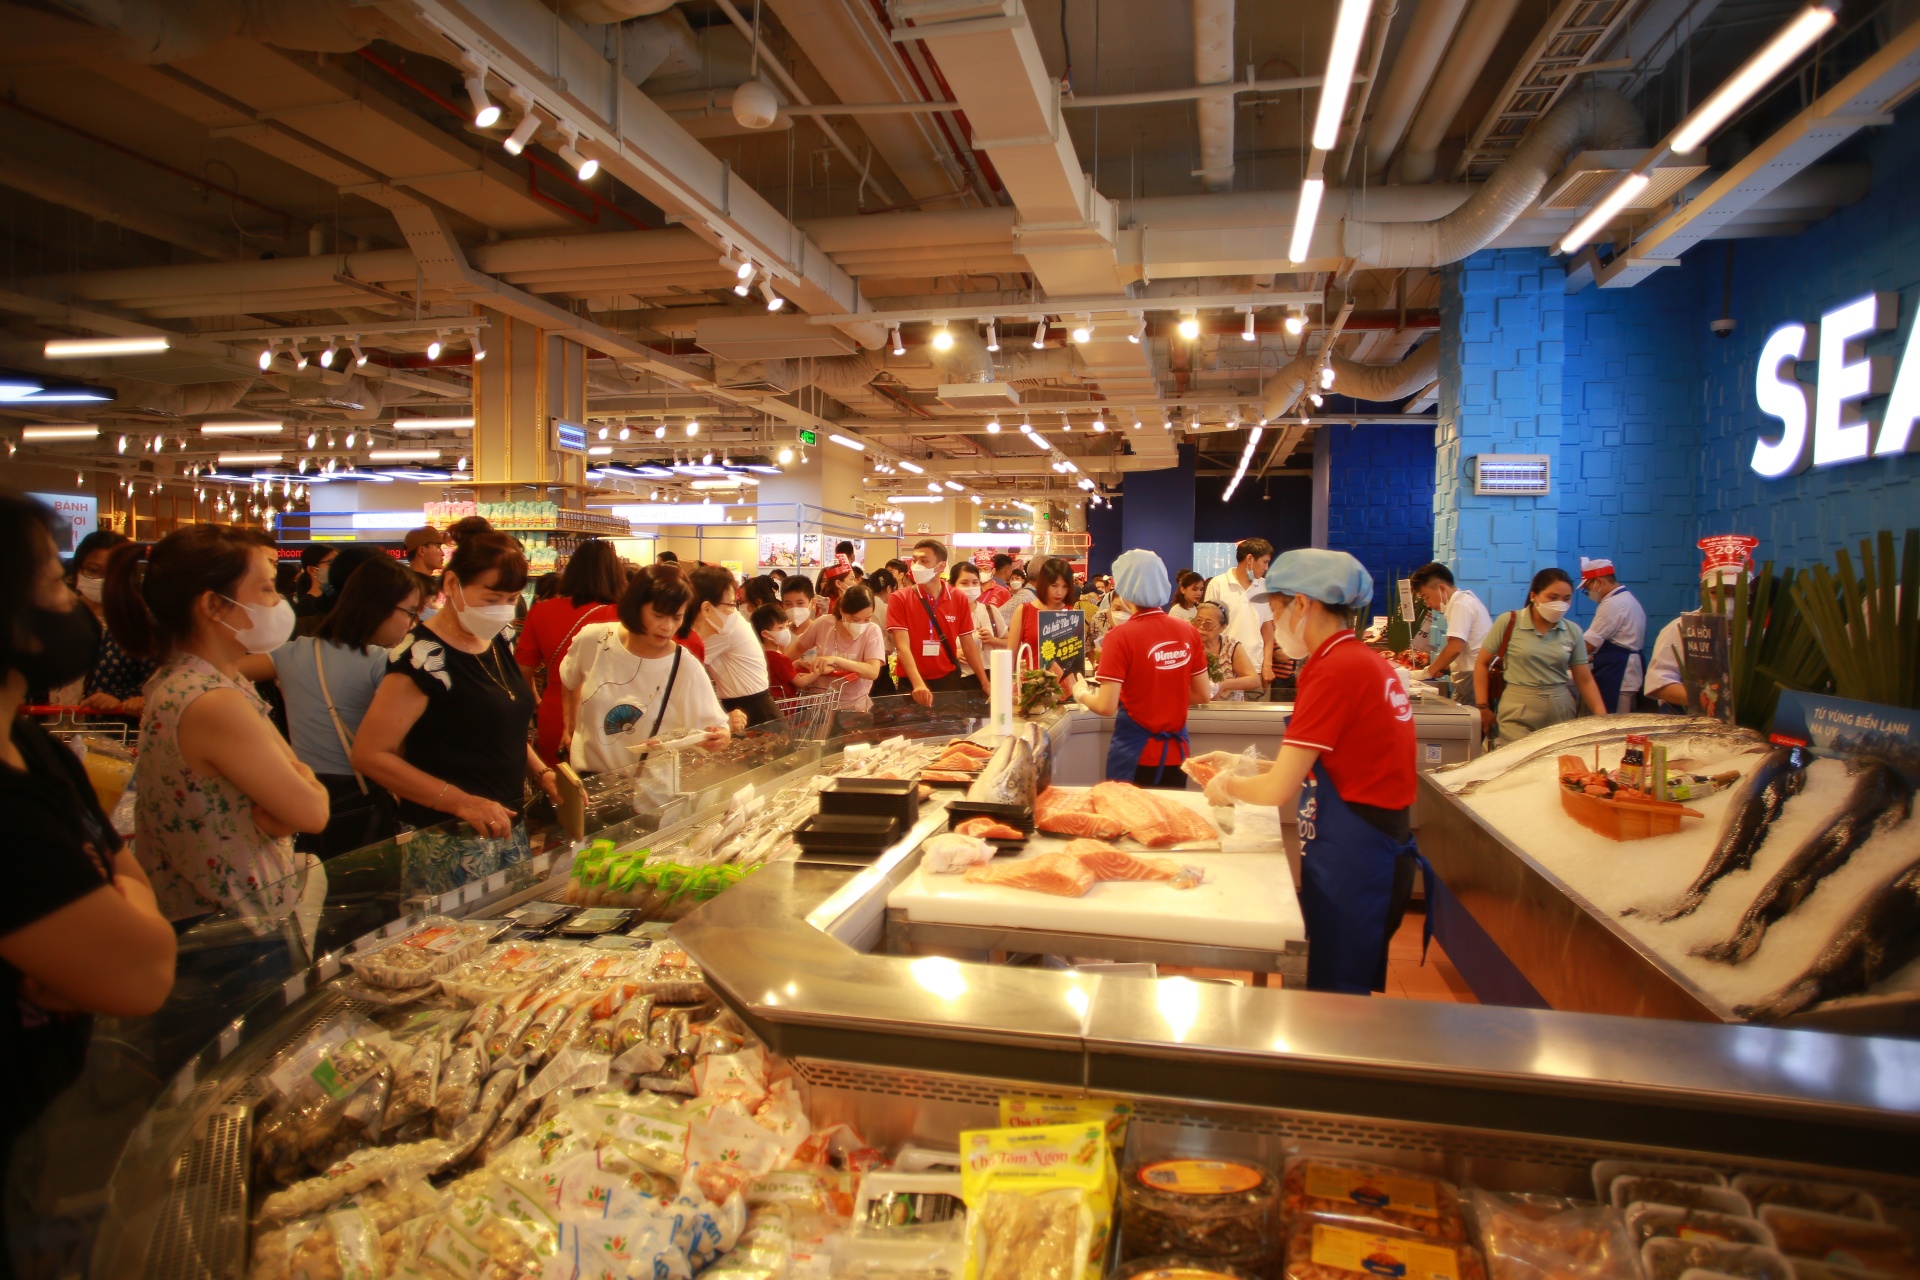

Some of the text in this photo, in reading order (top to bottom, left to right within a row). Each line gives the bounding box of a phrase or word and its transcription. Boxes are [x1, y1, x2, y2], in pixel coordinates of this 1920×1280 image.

[54, 500, 89, 512] BÁNH
[1715, 545, 1748, 556] 20%
[1686, 624, 1712, 639] CÁ HỒI
[1056, 643, 1074, 658] 499
[1687, 640, 1710, 653] NA UY
[1154, 649, 1188, 662] Vimex
[1814, 707, 1911, 736] TỪ VÙNG BIỂN LẠNH
[1810, 722, 1839, 737] NA UY
[1031, 1150, 1069, 1169] Ngon
